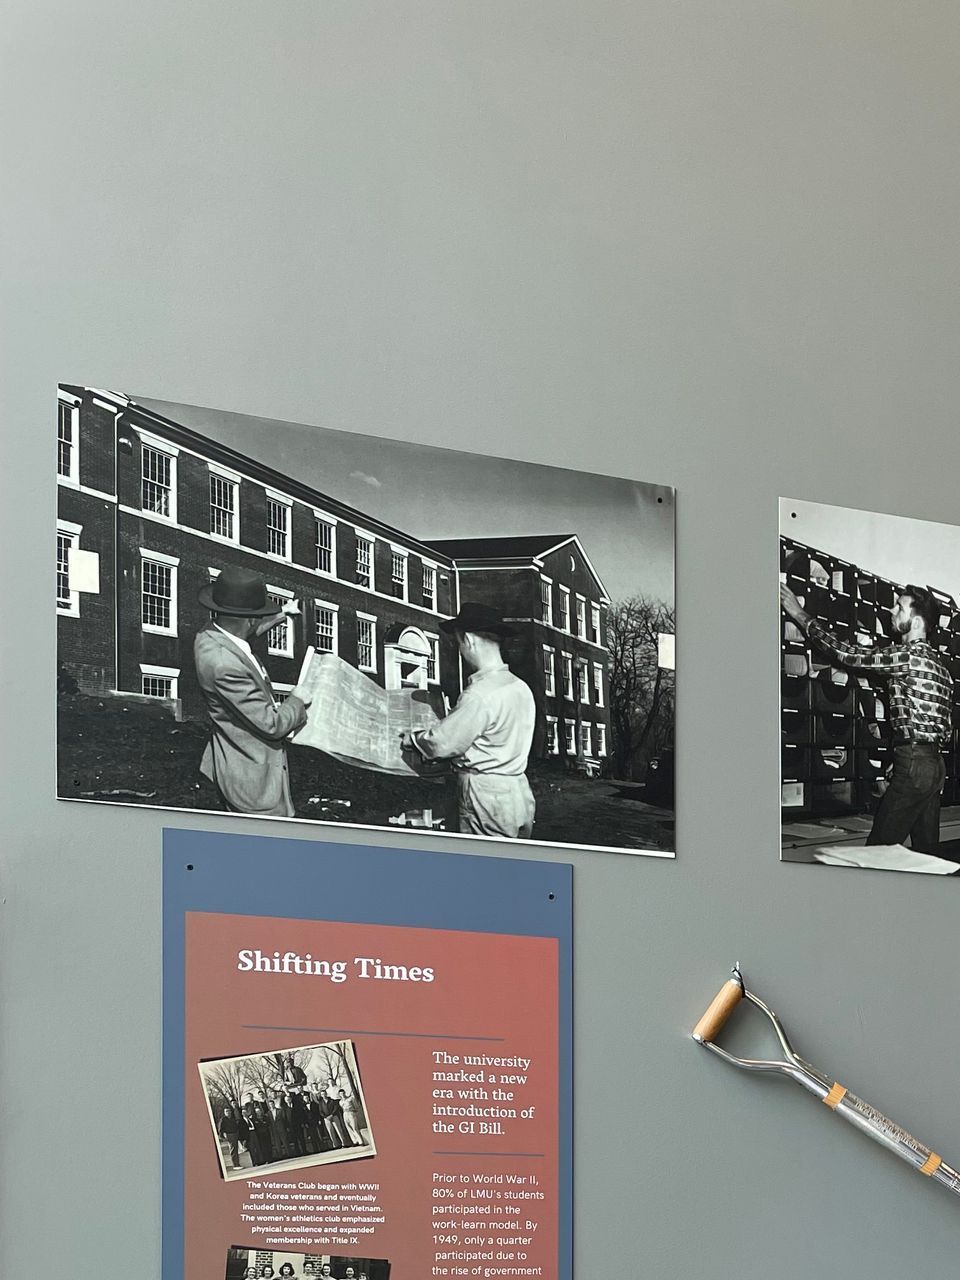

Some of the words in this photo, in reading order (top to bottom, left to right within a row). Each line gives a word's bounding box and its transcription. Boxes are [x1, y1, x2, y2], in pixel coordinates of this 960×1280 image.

[238, 950, 347, 983] Shifting
[354, 958, 434, 982] Times
[432, 1052, 459, 1064] The
[464, 1054, 531, 1071] university
[433, 1070, 485, 1083] marked
[489, 1075, 496, 1083] a
[500, 1075, 527, 1084] new
[433, 1089, 454, 1099] era
[457, 1088, 488, 1100] with
[492, 1088, 514, 1101] the
[433, 1103, 517, 1118] introduction
[521, 1106, 535, 1118] of
[433, 1120, 454, 1133] the
[459, 1122, 475, 1134] GI
[479, 1122, 505, 1135] Bill.
[433, 1173, 457, 1183] Prior
[460, 1174, 470, 1183] to
[473, 1174, 503, 1184] World
[506, 1175, 527, 1184] War
[530, 1176, 539, 1186] II,
[318, 1183, 340, 1191] began
[339, 1194, 376, 1202] eventually
[432, 1188, 454, 1198] 80%
[457, 1189, 468, 1198] of
[471, 1189, 502, 1199] LMU's
[504, 1190, 544, 1200] students
